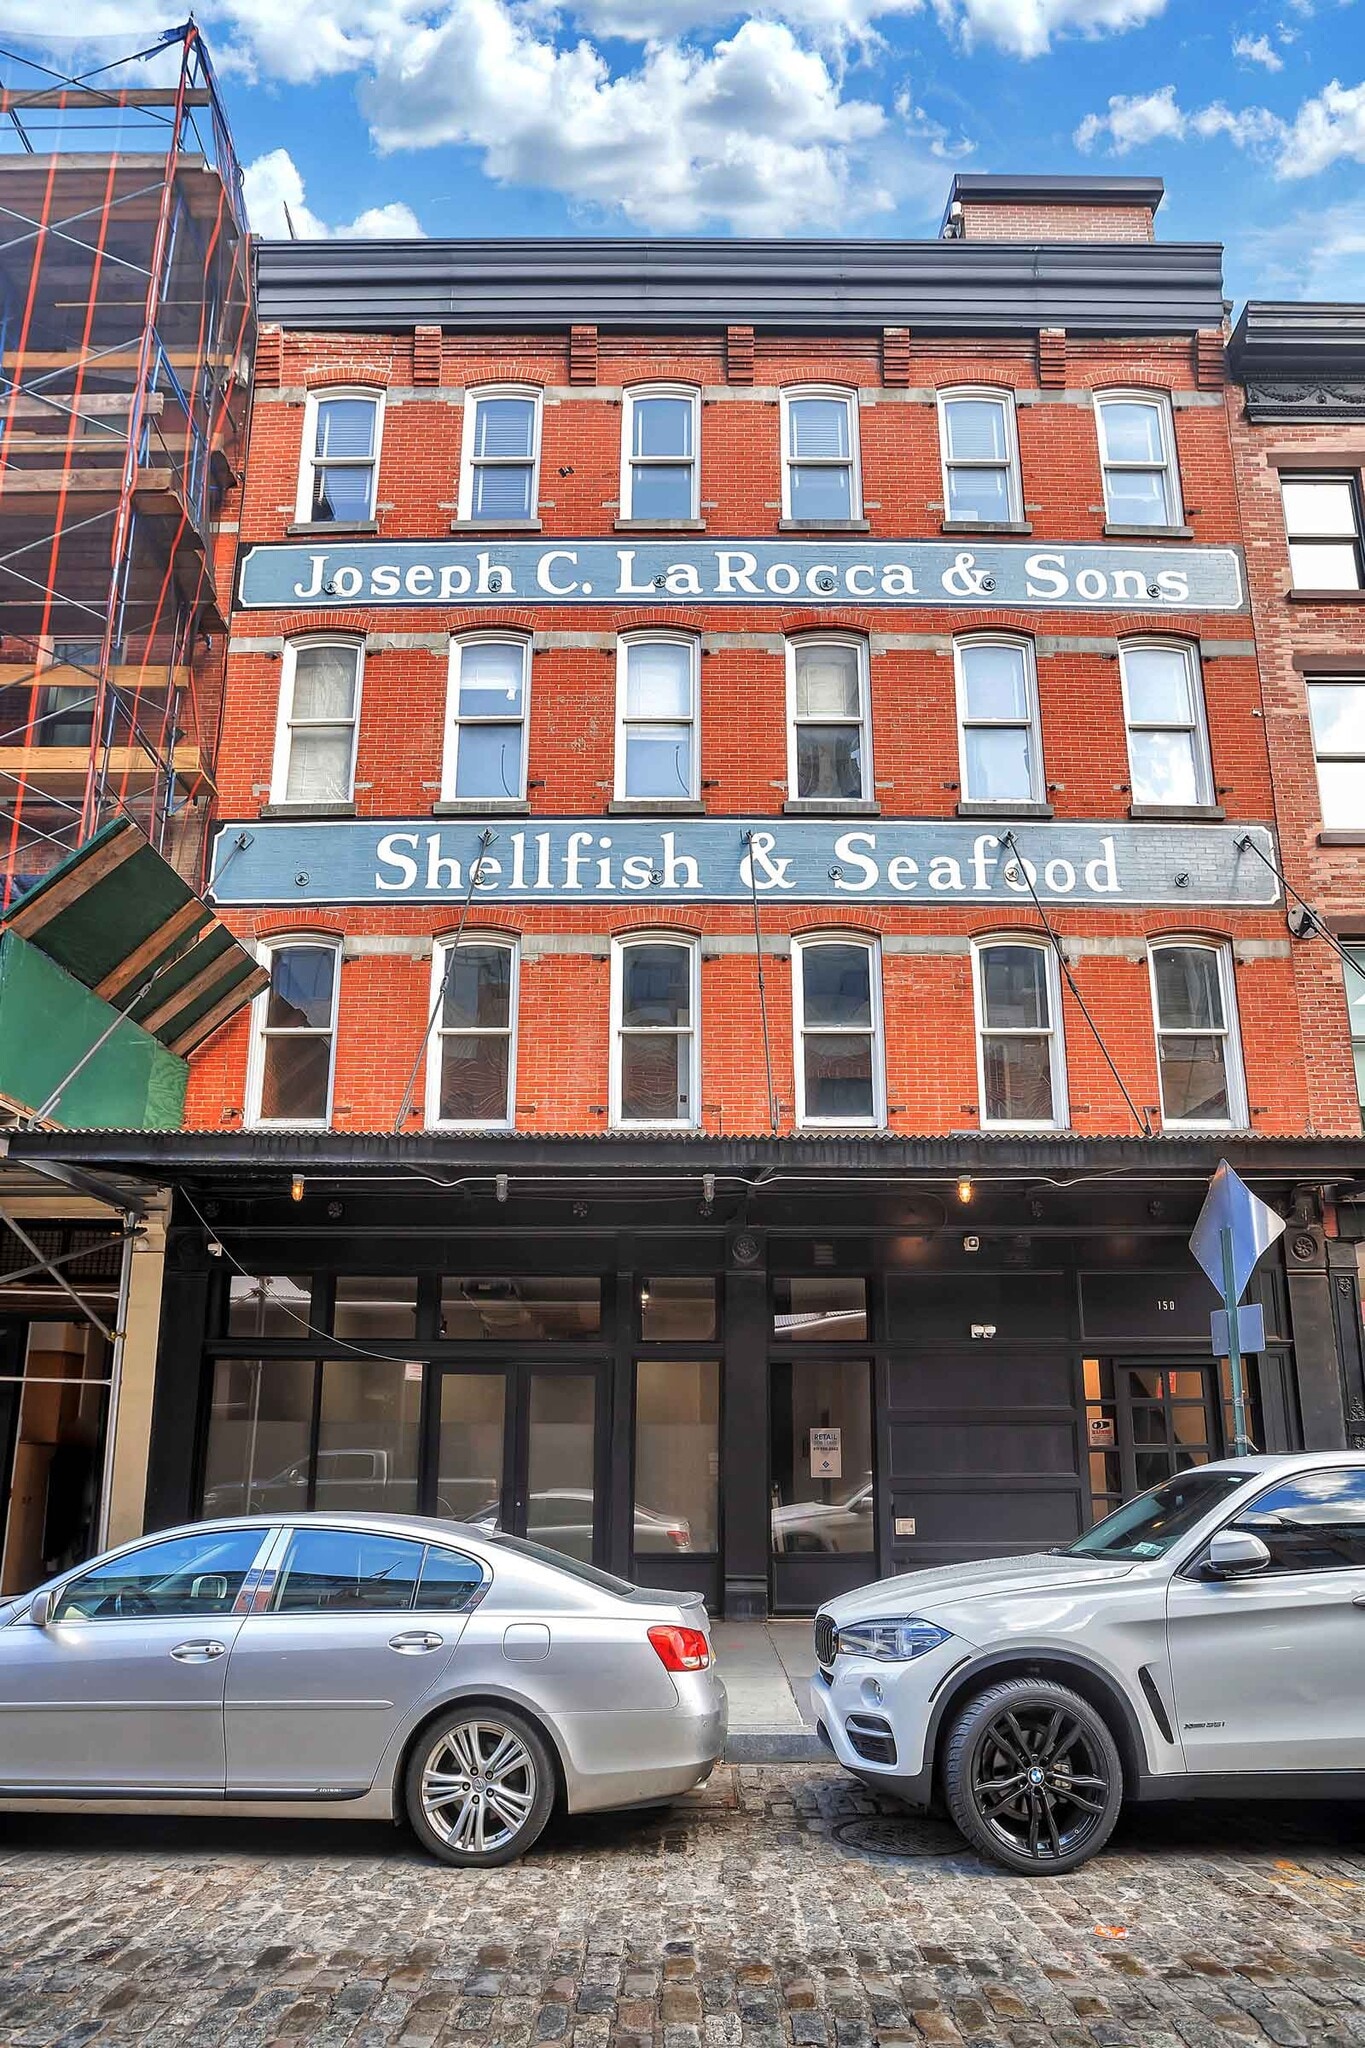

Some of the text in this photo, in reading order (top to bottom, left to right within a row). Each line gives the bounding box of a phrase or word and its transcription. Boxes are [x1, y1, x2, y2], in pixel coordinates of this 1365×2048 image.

[294, 551, 1190, 602] Joseph C. LaRocca & Sons
[375, 832, 1123, 893] Shellfish & Seafood
[1157, 1300, 1175, 1310] 150
